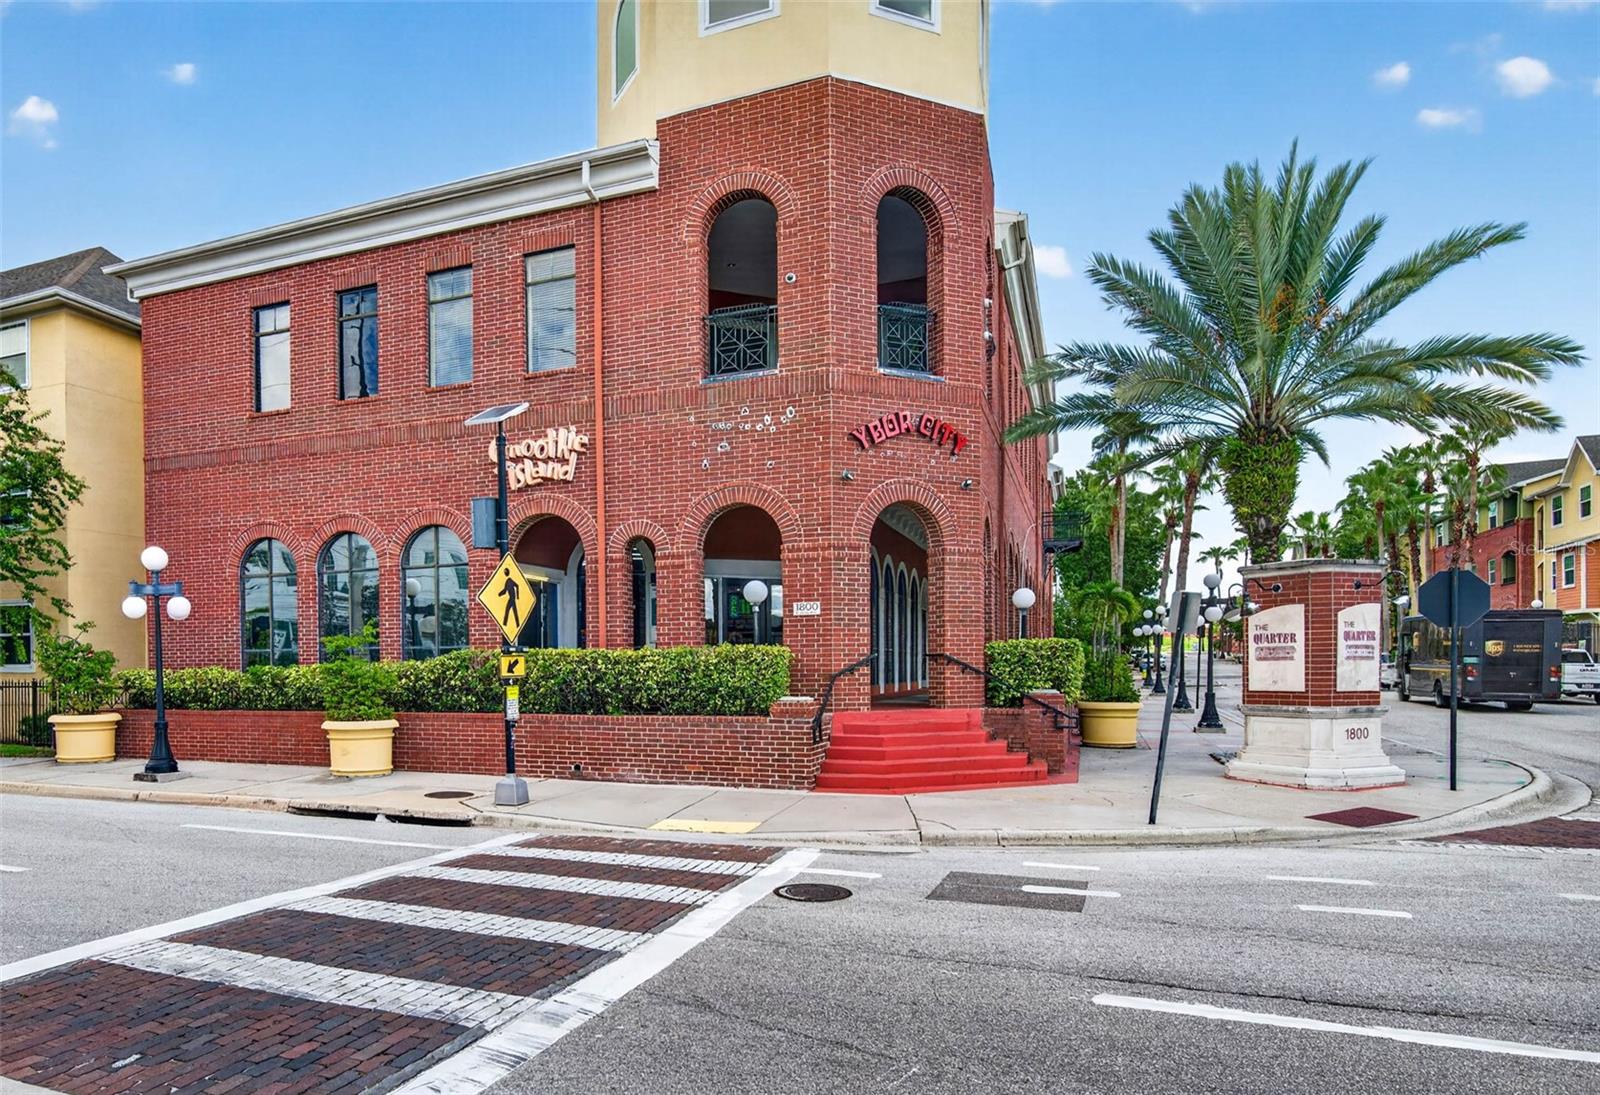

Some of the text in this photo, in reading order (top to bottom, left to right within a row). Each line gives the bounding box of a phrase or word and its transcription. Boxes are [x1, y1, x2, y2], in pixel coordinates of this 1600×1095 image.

[849, 411, 968, 455] YBOR CITY
[796, 603, 818, 611] 1800
[1253, 633, 1297, 645] QUARTER
[1343, 630, 1376, 642] QUARTER
[1345, 727, 1369, 740] 1800
